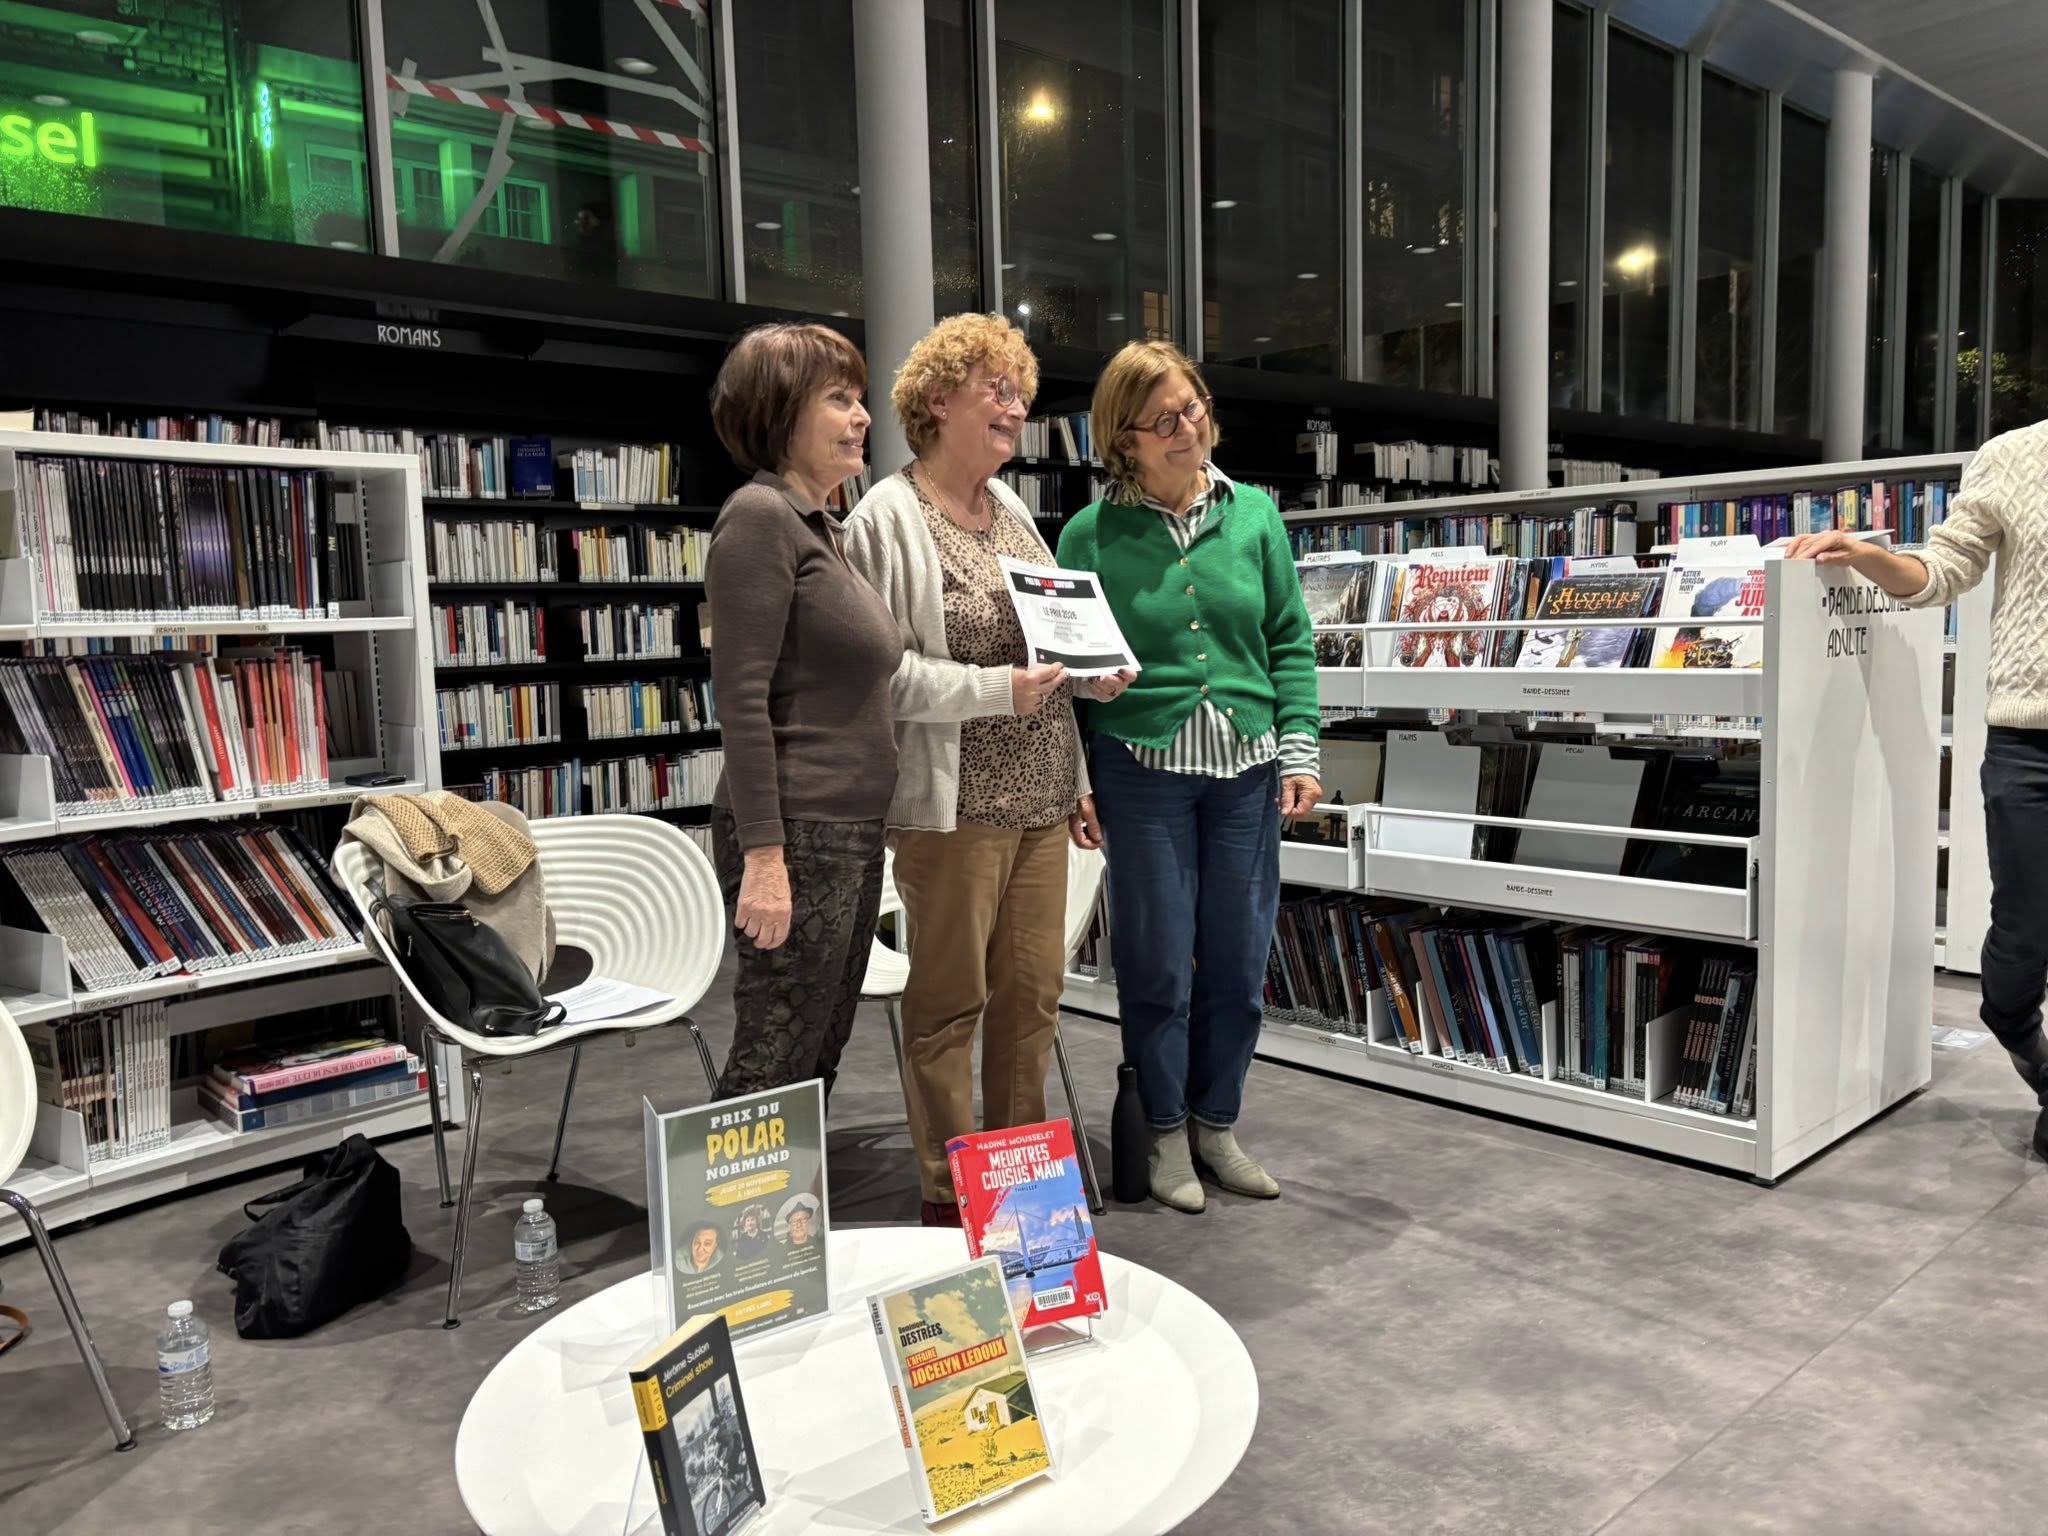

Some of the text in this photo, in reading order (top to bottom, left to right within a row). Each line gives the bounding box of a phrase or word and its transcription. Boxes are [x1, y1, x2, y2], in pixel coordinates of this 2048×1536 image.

[377, 324, 441, 348] ROMANS
[1412, 564, 1489, 594] Requiem
[1680, 577, 1705, 585] DORISON
[1828, 586, 1863, 617] BANDE
[1827, 627, 1867, 658] ADULTE
[152, 896, 174, 925] FINAL
[1518, 1008, 1529, 1029] d'or
[710, 1102, 780, 1129] PRIX DU
[706, 1117, 786, 1166] POLAR
[977, 1131, 1055, 1151] NADINE MOUSSELET
[706, 1150, 790, 1181] NORMAND
[989, 1143, 1050, 1169] MEURTRES
[981, 1166, 1031, 1190] COUSUS
[1034, 1159, 1065, 1182] MAIN
[1014, 1184, 1038, 1192] THRILLER
[686, 1296, 713, 1309] Rencontre
[712, 1293, 725, 1302] avec
[732, 1287, 745, 1296] trois
[1084, 1292, 1100, 1304] XO
[900, 1323, 943, 1349] DESTRÉES
[662, 1341, 711, 1384] Jérôme Sublon
[907, 1348, 937, 1368] L'AFFAIRE
[911, 1338, 1006, 1387] JOCELYN LEDOUX
[665, 1355, 715, 1398] Criminel show
